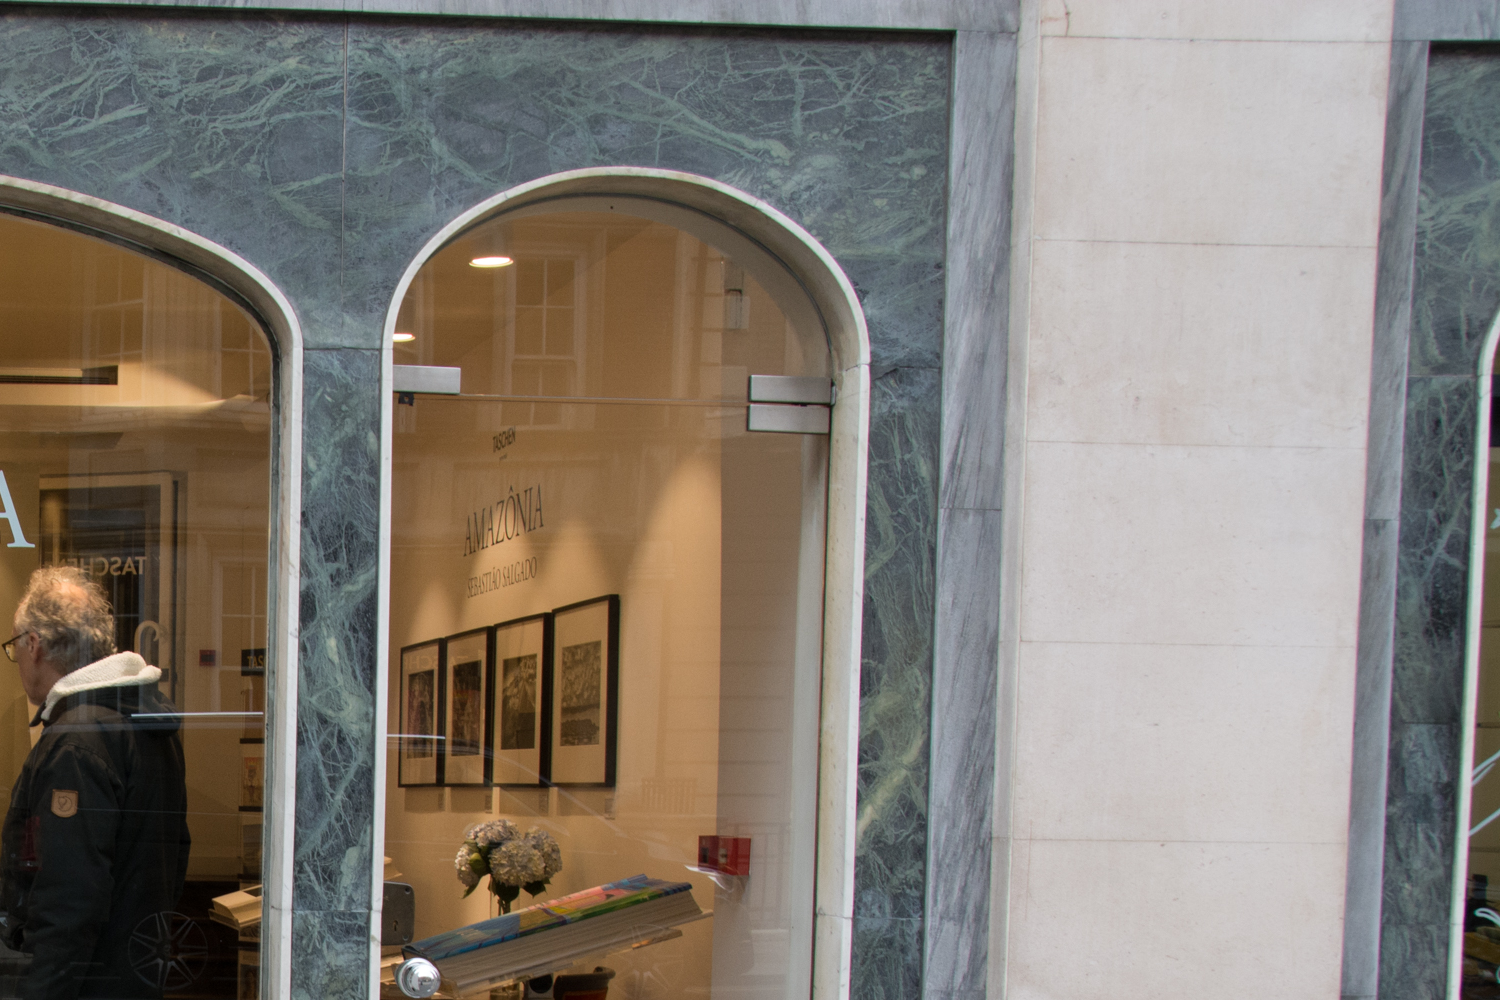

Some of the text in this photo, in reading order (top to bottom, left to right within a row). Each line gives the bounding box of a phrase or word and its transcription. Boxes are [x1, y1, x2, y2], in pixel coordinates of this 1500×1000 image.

[463, 484, 544, 557] AMAZÔNIA
[467, 556, 538, 599] SEBASTIÃO SALGADO
